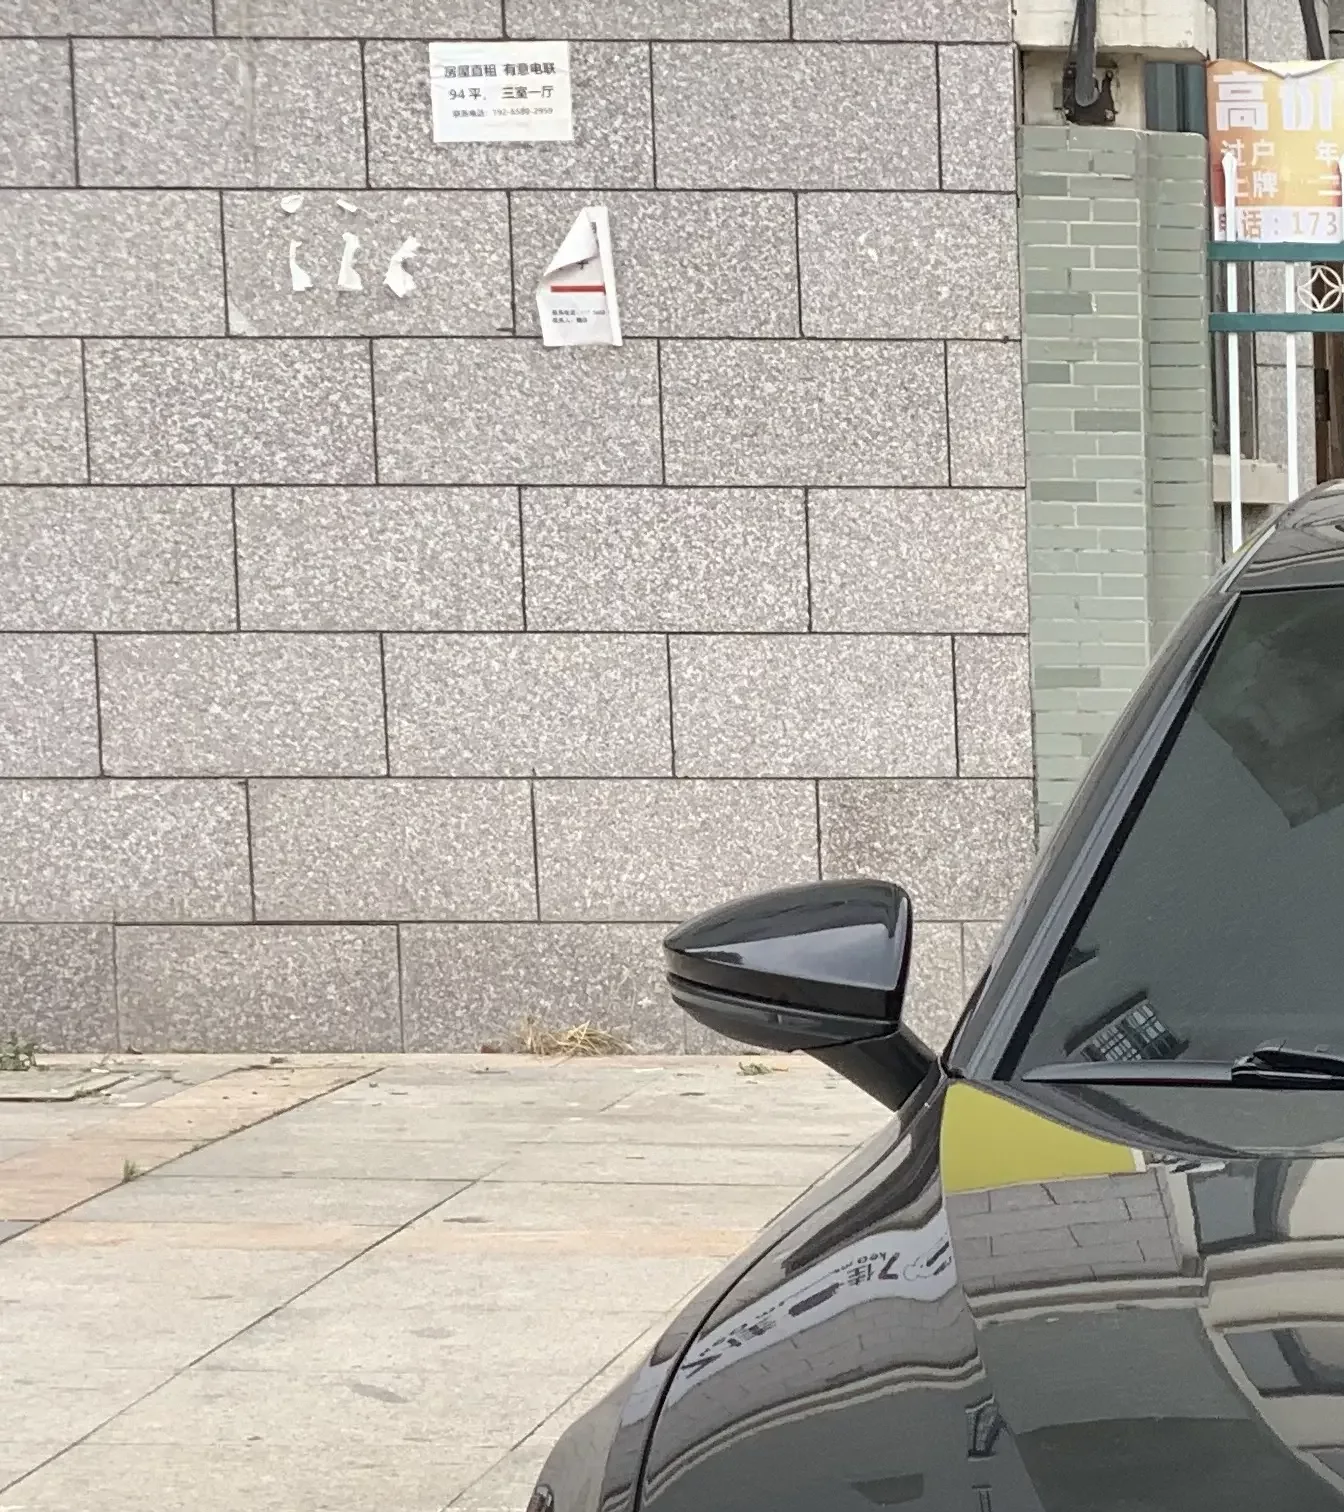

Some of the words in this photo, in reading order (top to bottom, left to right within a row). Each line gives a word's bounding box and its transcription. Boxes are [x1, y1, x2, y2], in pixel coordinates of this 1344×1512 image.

[501, 85, 554, 99] 三室一厅
[1213, 71, 1333, 131] 高价
